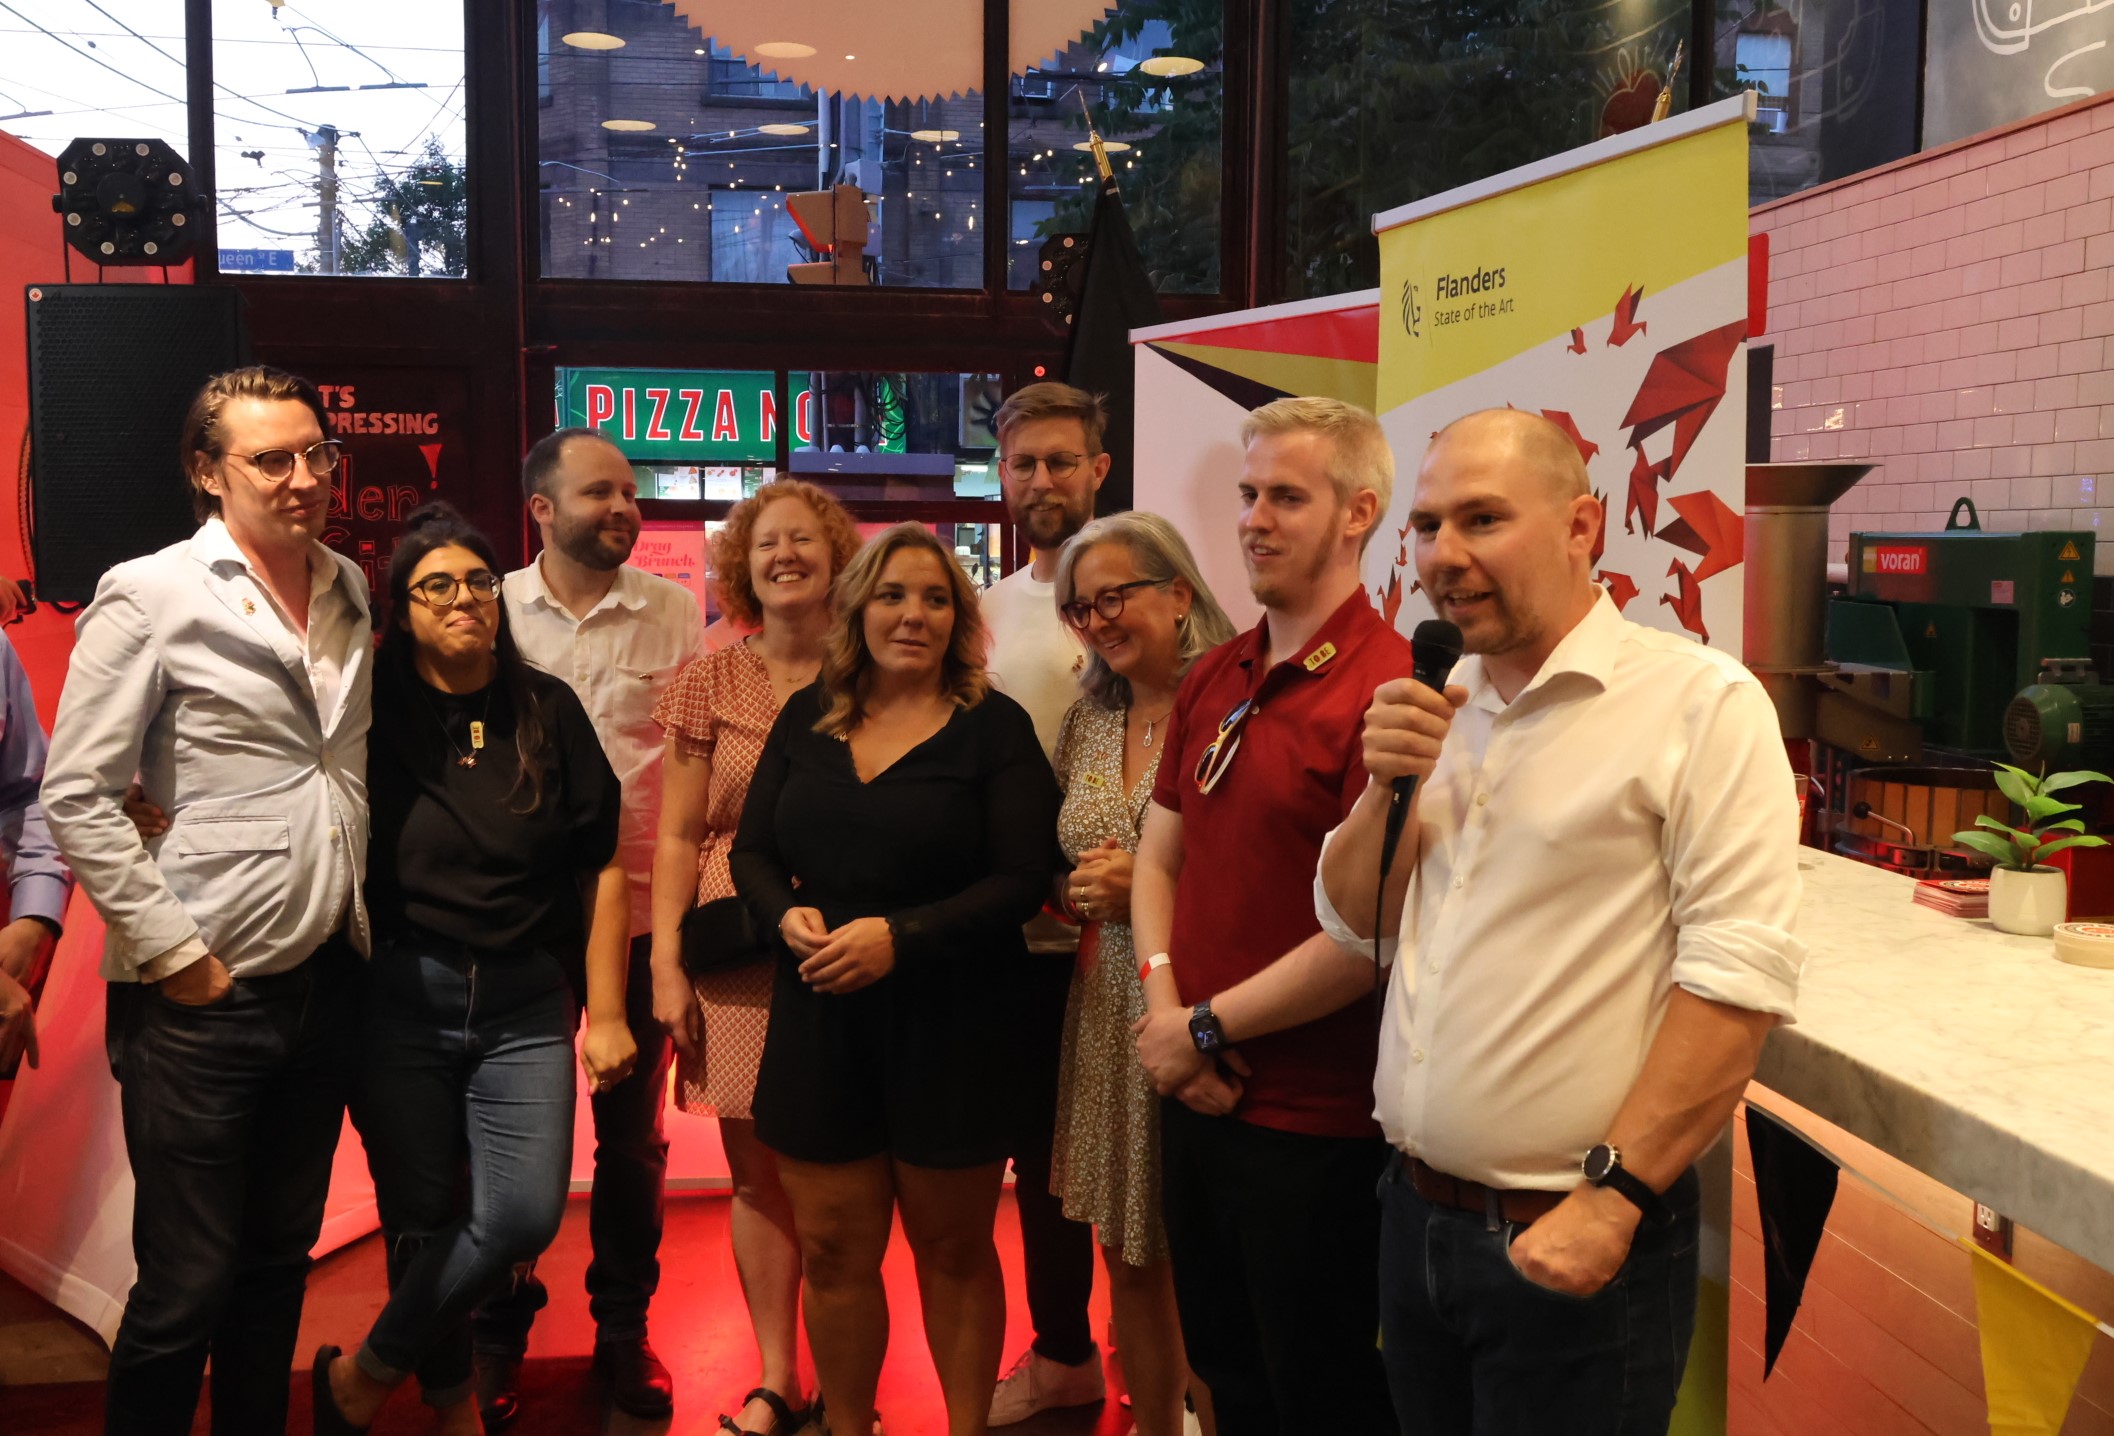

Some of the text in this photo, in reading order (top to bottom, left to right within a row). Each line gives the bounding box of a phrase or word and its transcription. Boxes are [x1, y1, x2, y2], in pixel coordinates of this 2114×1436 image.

[219, 253, 253, 266] ueen
[269, 252, 277, 265] E
[1436, 266, 1506, 301] Flanders
[1434, 298, 1514, 327] State of the Art
[318, 385, 355, 409] T'S
[586, 385, 739, 442] PIZZA
[633, 541, 672, 555] Drag
[1880, 552, 1920, 571] voran
